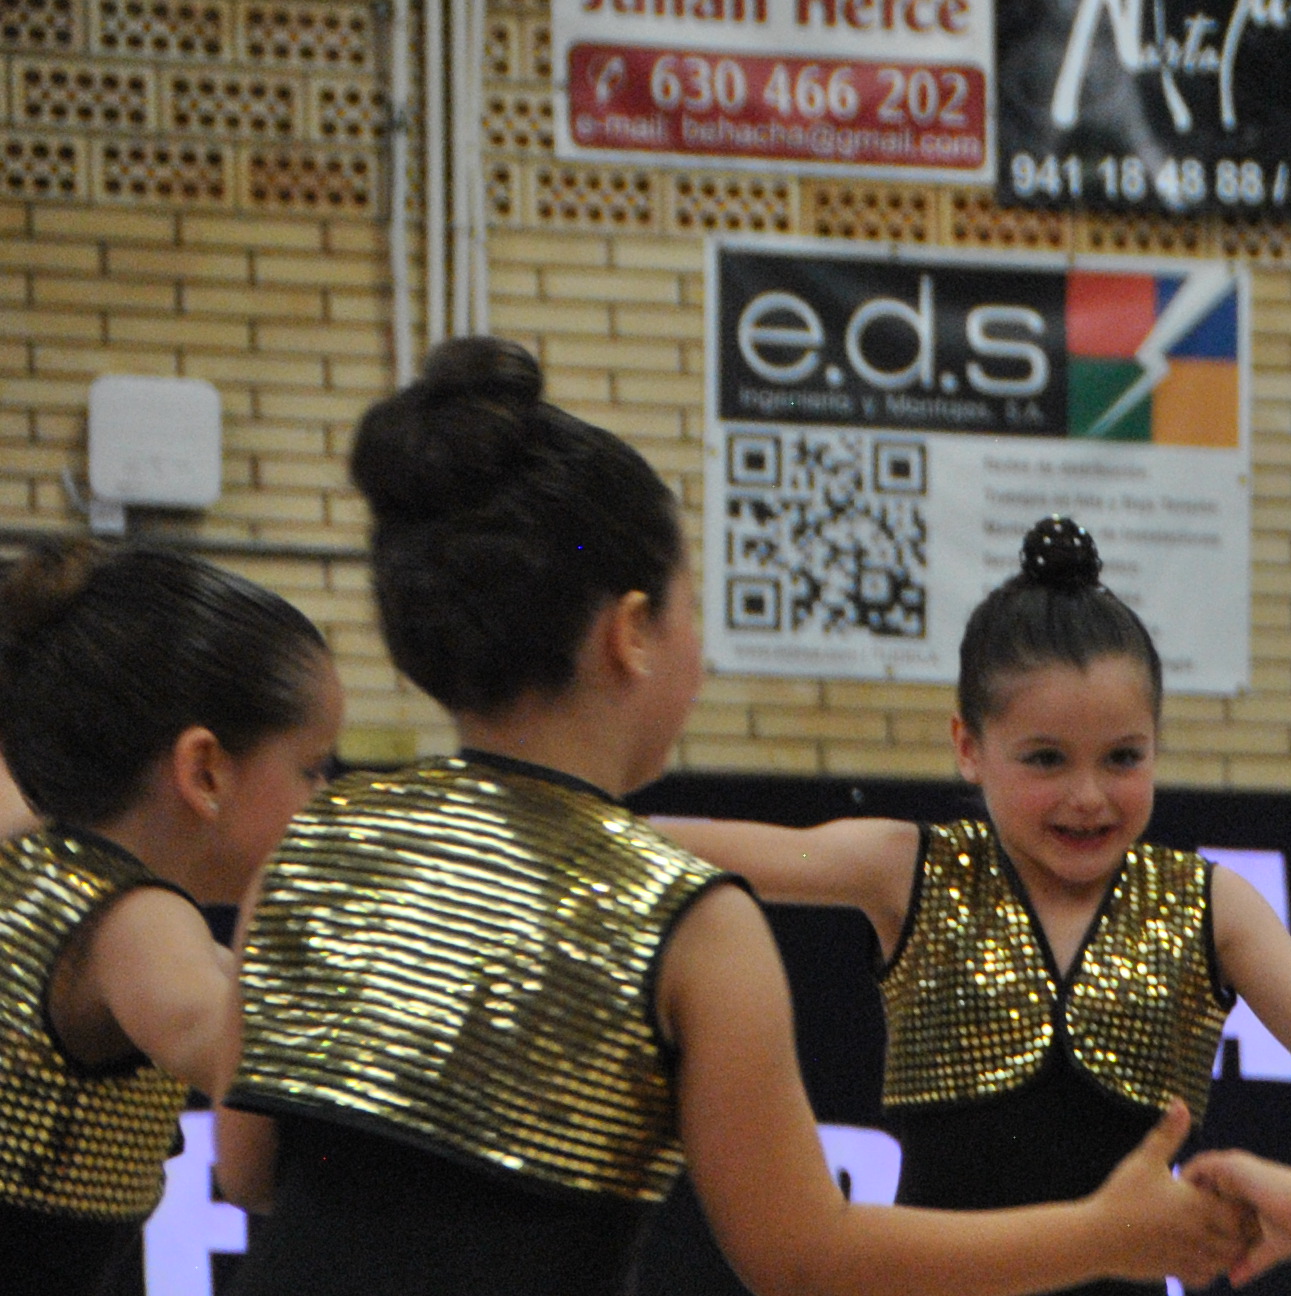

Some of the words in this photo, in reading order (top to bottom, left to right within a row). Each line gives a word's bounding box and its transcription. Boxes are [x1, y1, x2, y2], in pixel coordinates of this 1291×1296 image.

[651, 54, 747, 112] 630
[764, 63, 859, 121] 466
[877, 68, 970, 127] 202
[1011, 153, 1083, 197] 941
[1099, 156, 1147, 198] 18
[1156, 158, 1205, 205] 48
[1214, 160, 1266, 205] 88
[738, 273, 1051, 398] e.d.s
